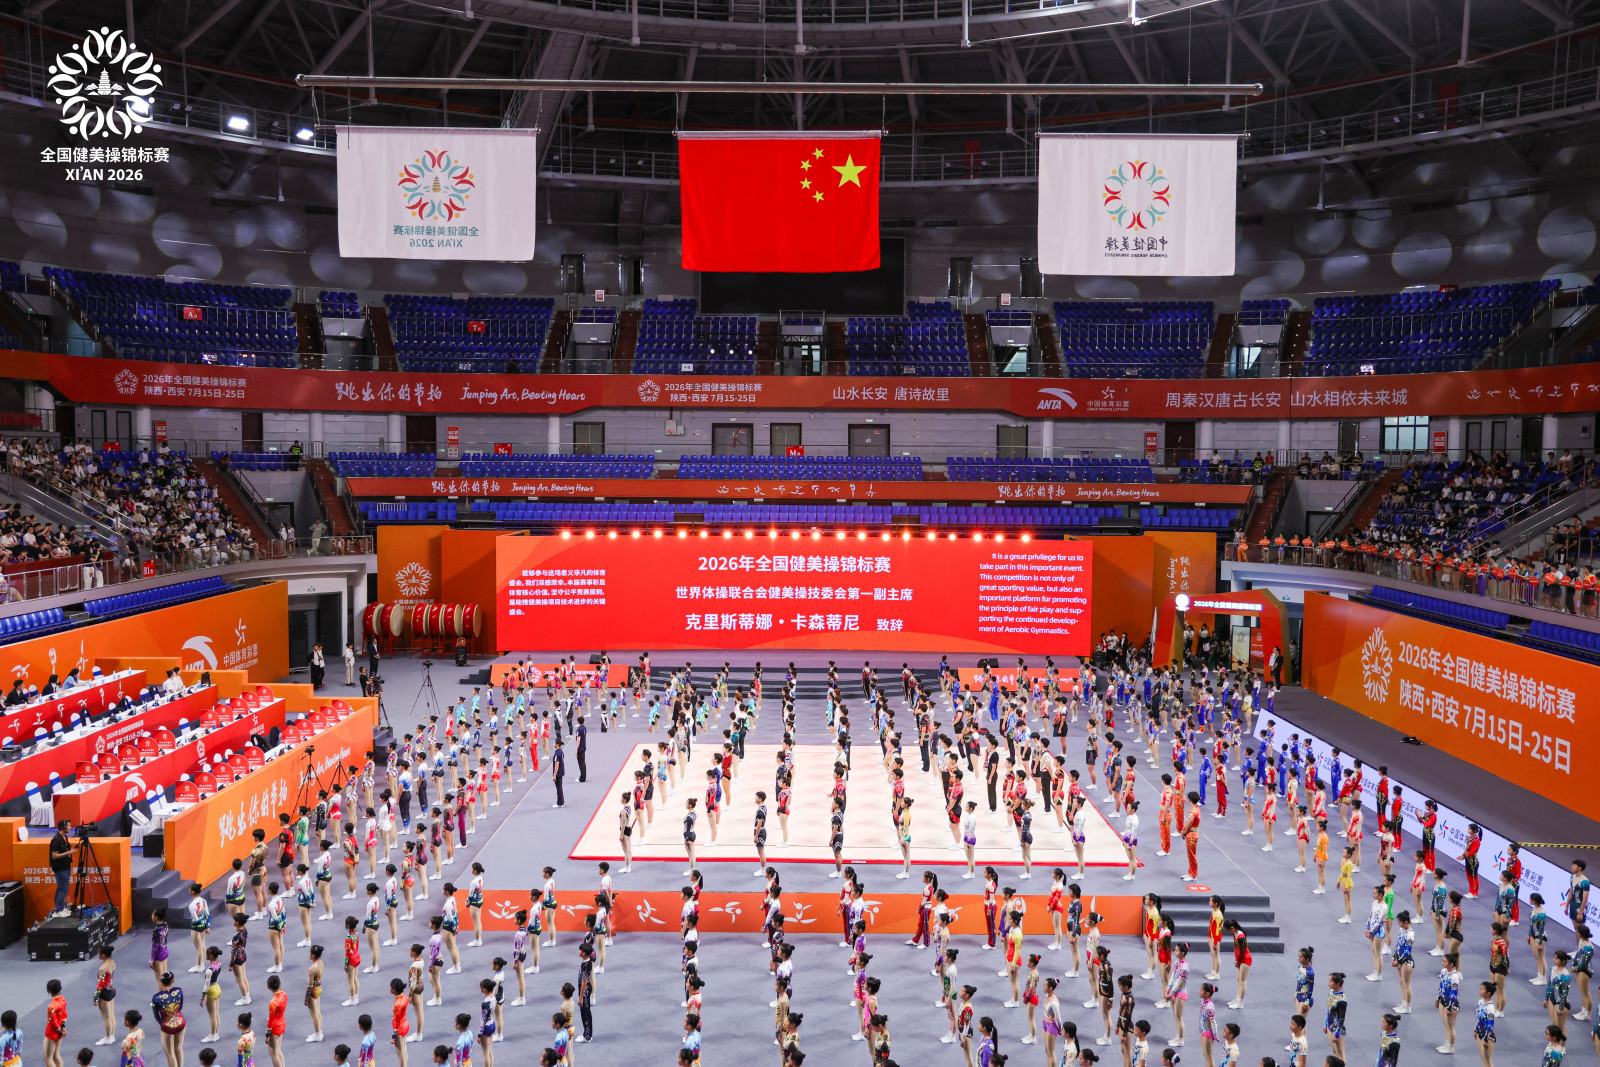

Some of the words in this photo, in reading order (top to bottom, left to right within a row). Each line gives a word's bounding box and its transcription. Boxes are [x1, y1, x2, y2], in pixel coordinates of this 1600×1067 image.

[142, 374, 247, 388] 2026年全国健美操锦标赛
[664, 383, 762, 392] 2026年全国健美操锦标赛
[144, 385, 186, 397] 陕西·西安
[188, 386, 245, 399] 7月15日-25日
[335, 381, 442, 406] 跳出你的节拍
[460, 386, 498, 405] Jumping
[521, 388, 557, 404] Beating
[558, 388, 586, 401] Heart
[710, 393, 756, 403] 7月15-25日
[832, 386, 888, 401] 山水长安
[894, 387, 950, 402] 唐诗故里
[1165, 392, 1281, 408] 周秦汉唐古长安
[1290, 388, 1408, 407] 山水相依未来城
[1036, 400, 1062, 410] ANTA
[510, 483, 536, 495] Jumping
[551, 483, 575, 494] Beating
[1076, 488, 1101, 499] Jumping
[698, 555, 892, 573] 2026年全国健美操锦标赛
[676, 586, 914, 601] 世界体操联合会健美操技委会第一副主席
[876, 618, 904, 632] 致辞
[223, 643, 258, 668] 中国体育彩票
[1398, 641, 1576, 724] 2026年全国健美操锦标赛
[1400, 678, 1460, 729] 陕西·西安
[1463, 704, 1571, 774] 7月15日-25日
[219, 778, 288, 848] 跳出你的节拍
